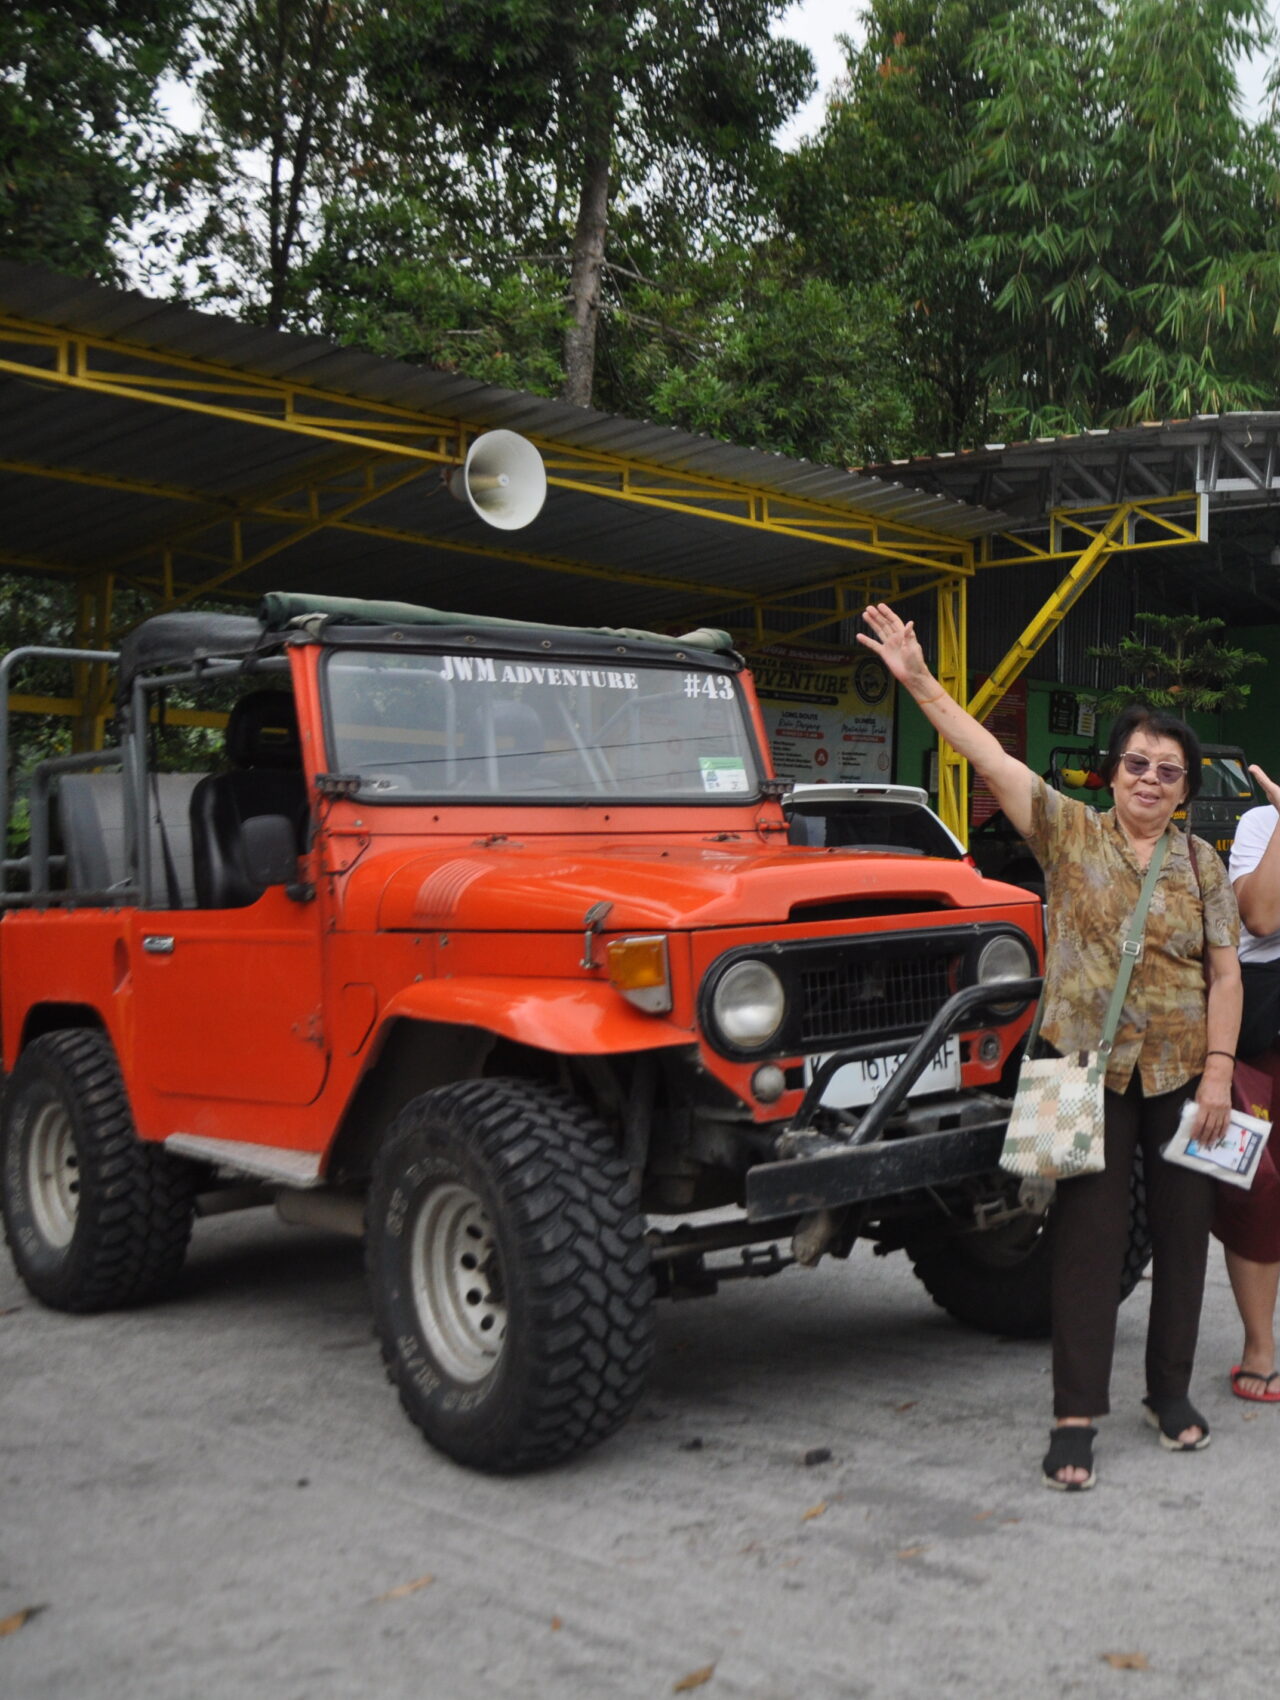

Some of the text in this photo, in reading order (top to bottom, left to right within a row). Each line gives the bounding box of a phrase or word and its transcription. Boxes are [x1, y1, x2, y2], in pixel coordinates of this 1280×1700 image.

[440, 656, 638, 690] JWM ADVENTURE
[684, 673, 735, 700] #43
[754, 668, 849, 694] DVENTURE
